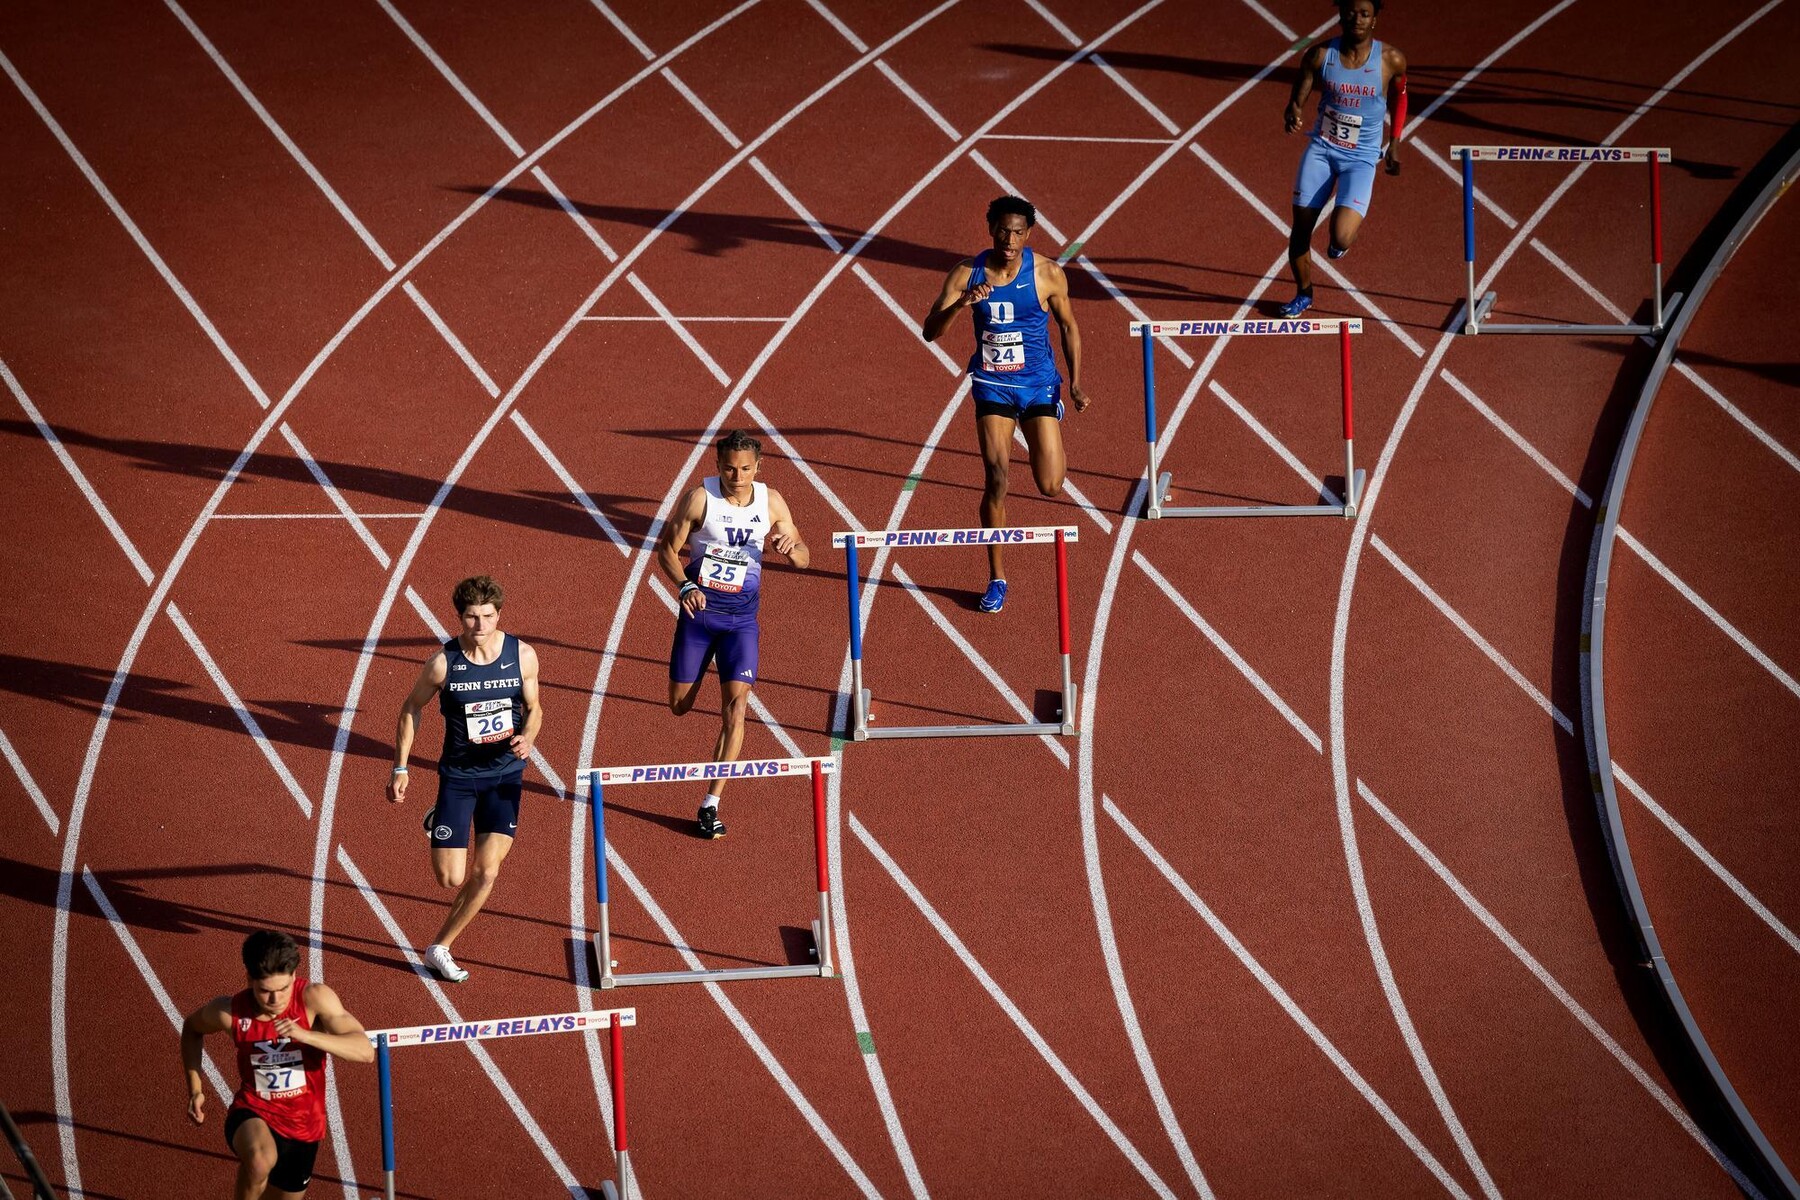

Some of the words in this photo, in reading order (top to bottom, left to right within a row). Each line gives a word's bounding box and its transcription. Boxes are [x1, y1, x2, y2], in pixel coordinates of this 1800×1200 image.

[1331, 96, 1361, 108] TATE
[1328, 122, 1350, 140] 33
[1330, 137, 1353, 149] TOYOTA
[1497, 148, 1544, 160] PENN
[1557, 149, 1622, 161] RELAYS
[988, 301, 1015, 324] D
[1179, 322, 1229, 334] PENN
[1243, 321, 1311, 334] RELAYS
[991, 348, 1015, 363] 24
[724, 527, 754, 547] W
[885, 531, 937, 545] PENN
[953, 529, 1024, 544] RELAYS
[709, 563, 737, 582] 25
[710, 580, 737, 592] TOYOTA
[449, 682, 481, 692] PENN
[484, 678, 520, 689] STATE
[478, 715, 504, 736] 26
[482, 731, 511, 742] TOYOTA
[632, 767, 686, 782] PENN
[703, 761, 779, 779] RELAYS
[420, 1024, 479, 1043] PENN
[495, 1015, 576, 1036] RELAYS
[265, 1070, 292, 1090] 27
[271, 1088, 303, 1099] TOYOTA
